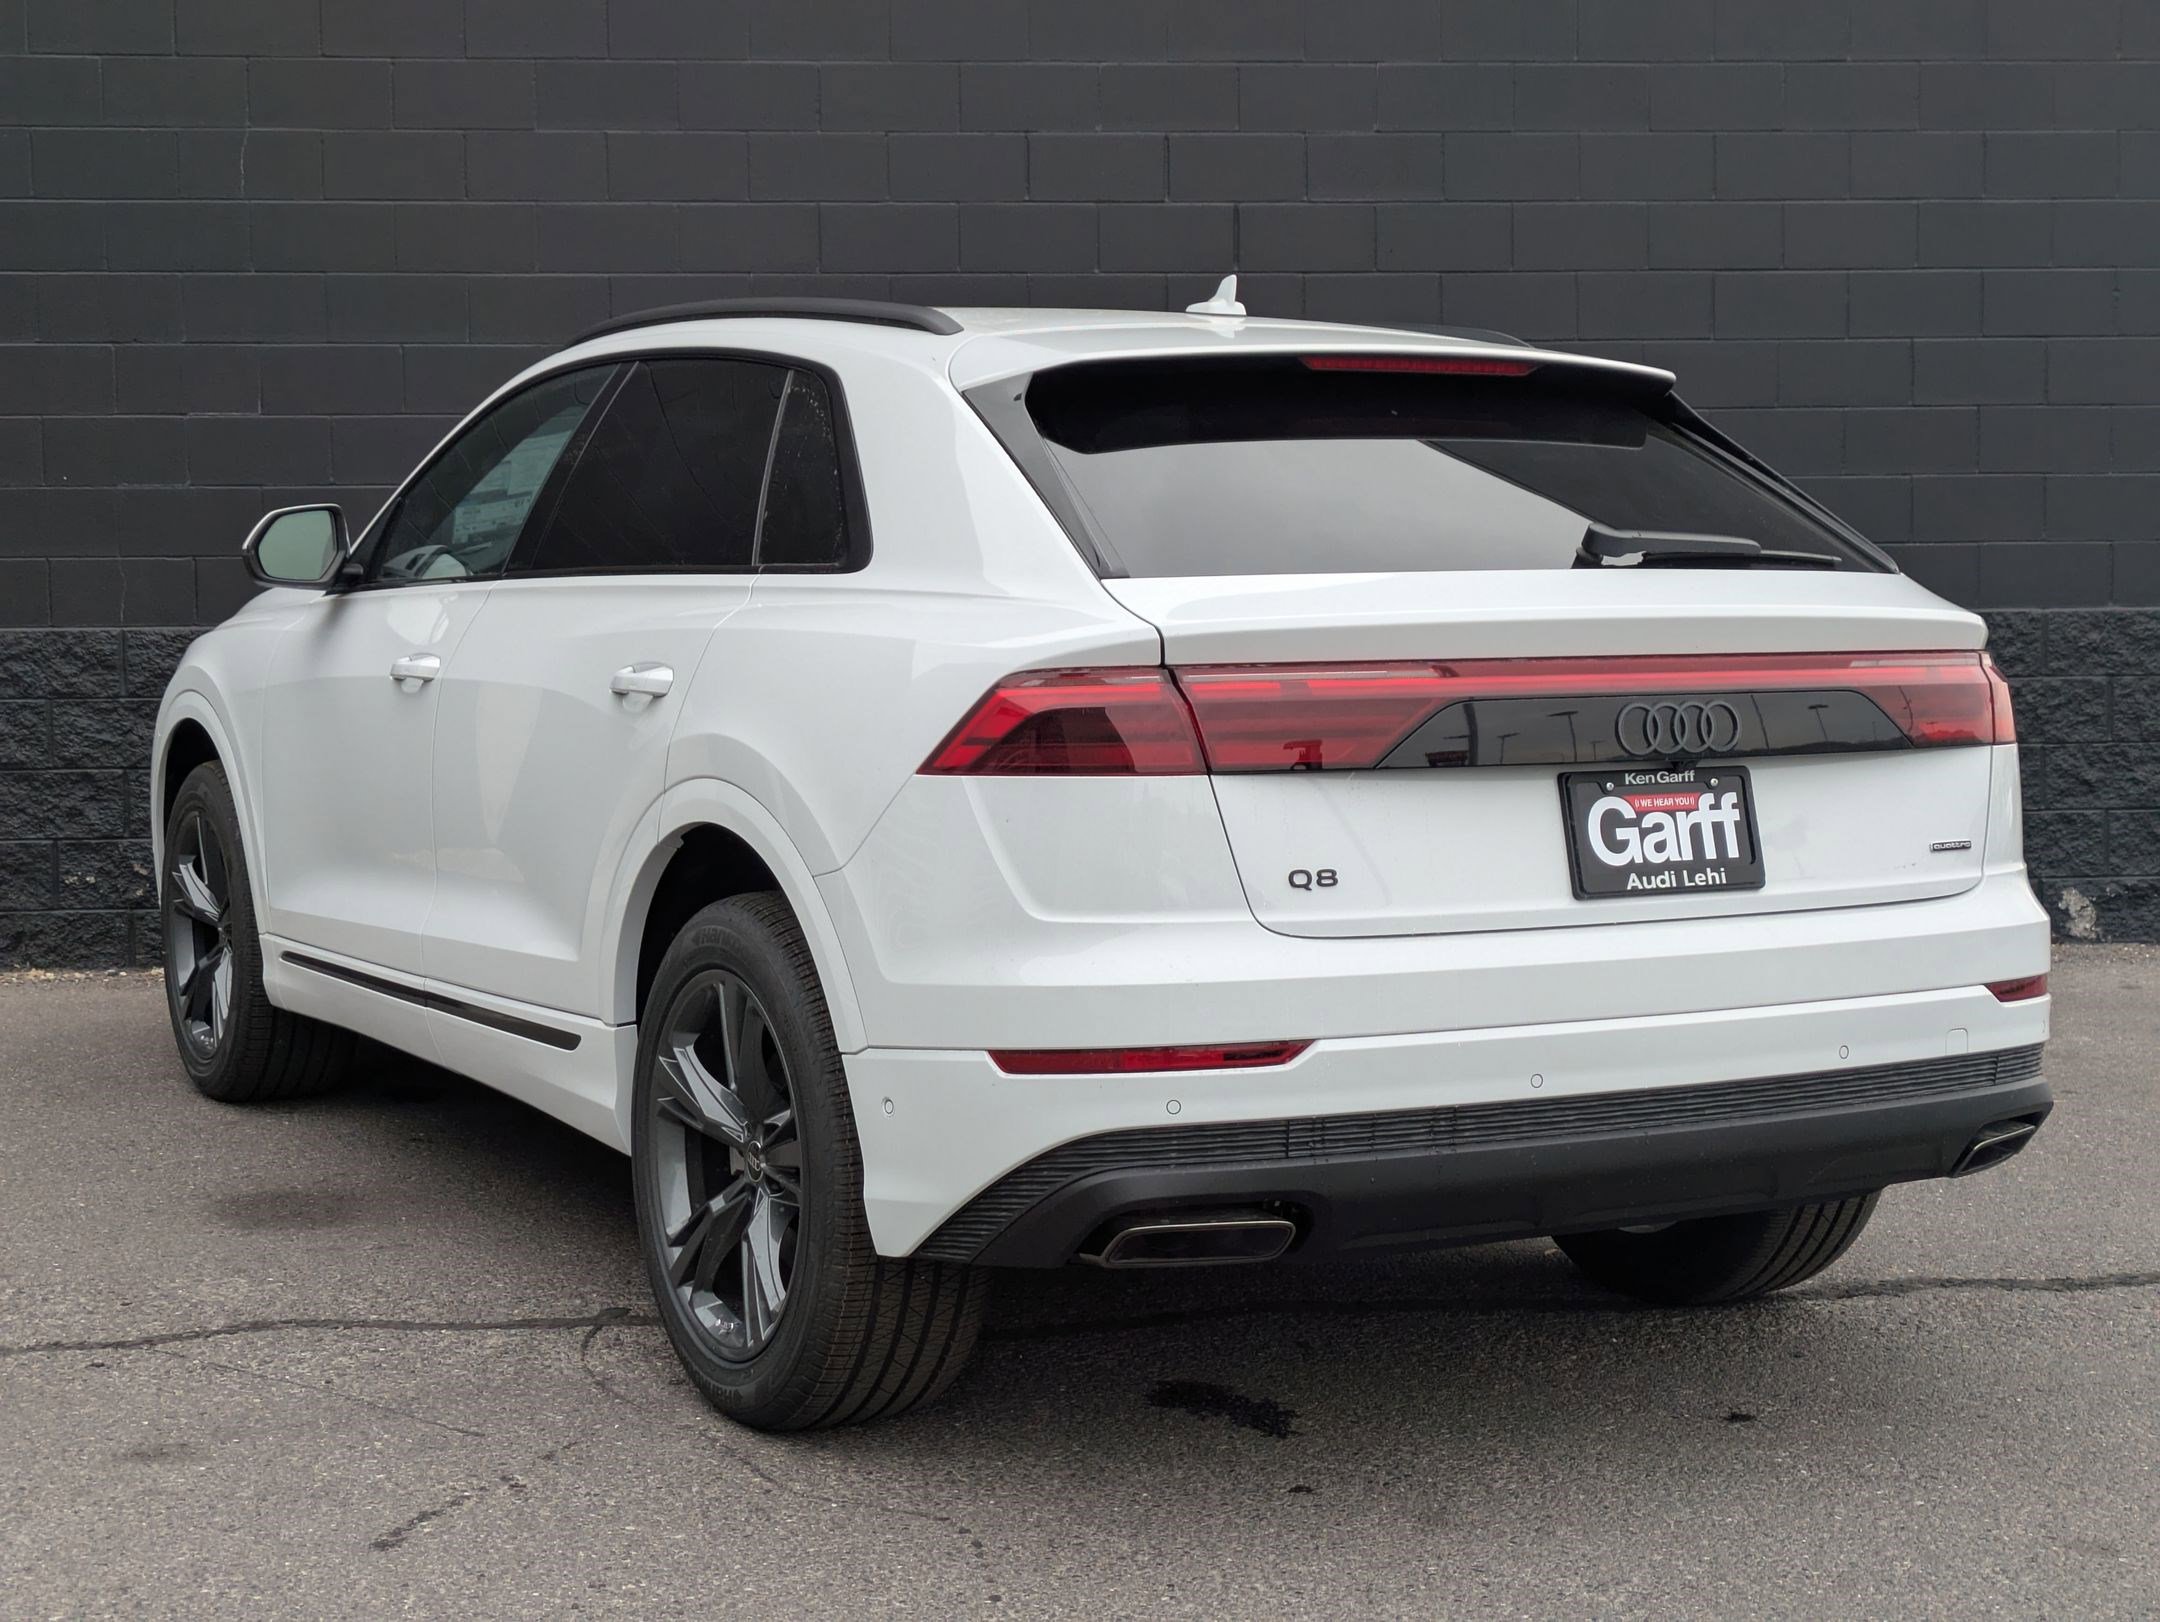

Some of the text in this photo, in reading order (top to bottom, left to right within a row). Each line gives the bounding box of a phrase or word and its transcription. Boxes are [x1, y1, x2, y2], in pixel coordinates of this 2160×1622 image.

[1624, 769, 1696, 785] Ken Garff
[1640, 796, 1690, 808] WE HEAR YOU
[1588, 792, 1740, 867] Garff
[1933, 841, 1971, 850] quattro
[1288, 869, 1339, 891] Q8
[1626, 867, 1727, 890] Audi Lehi
